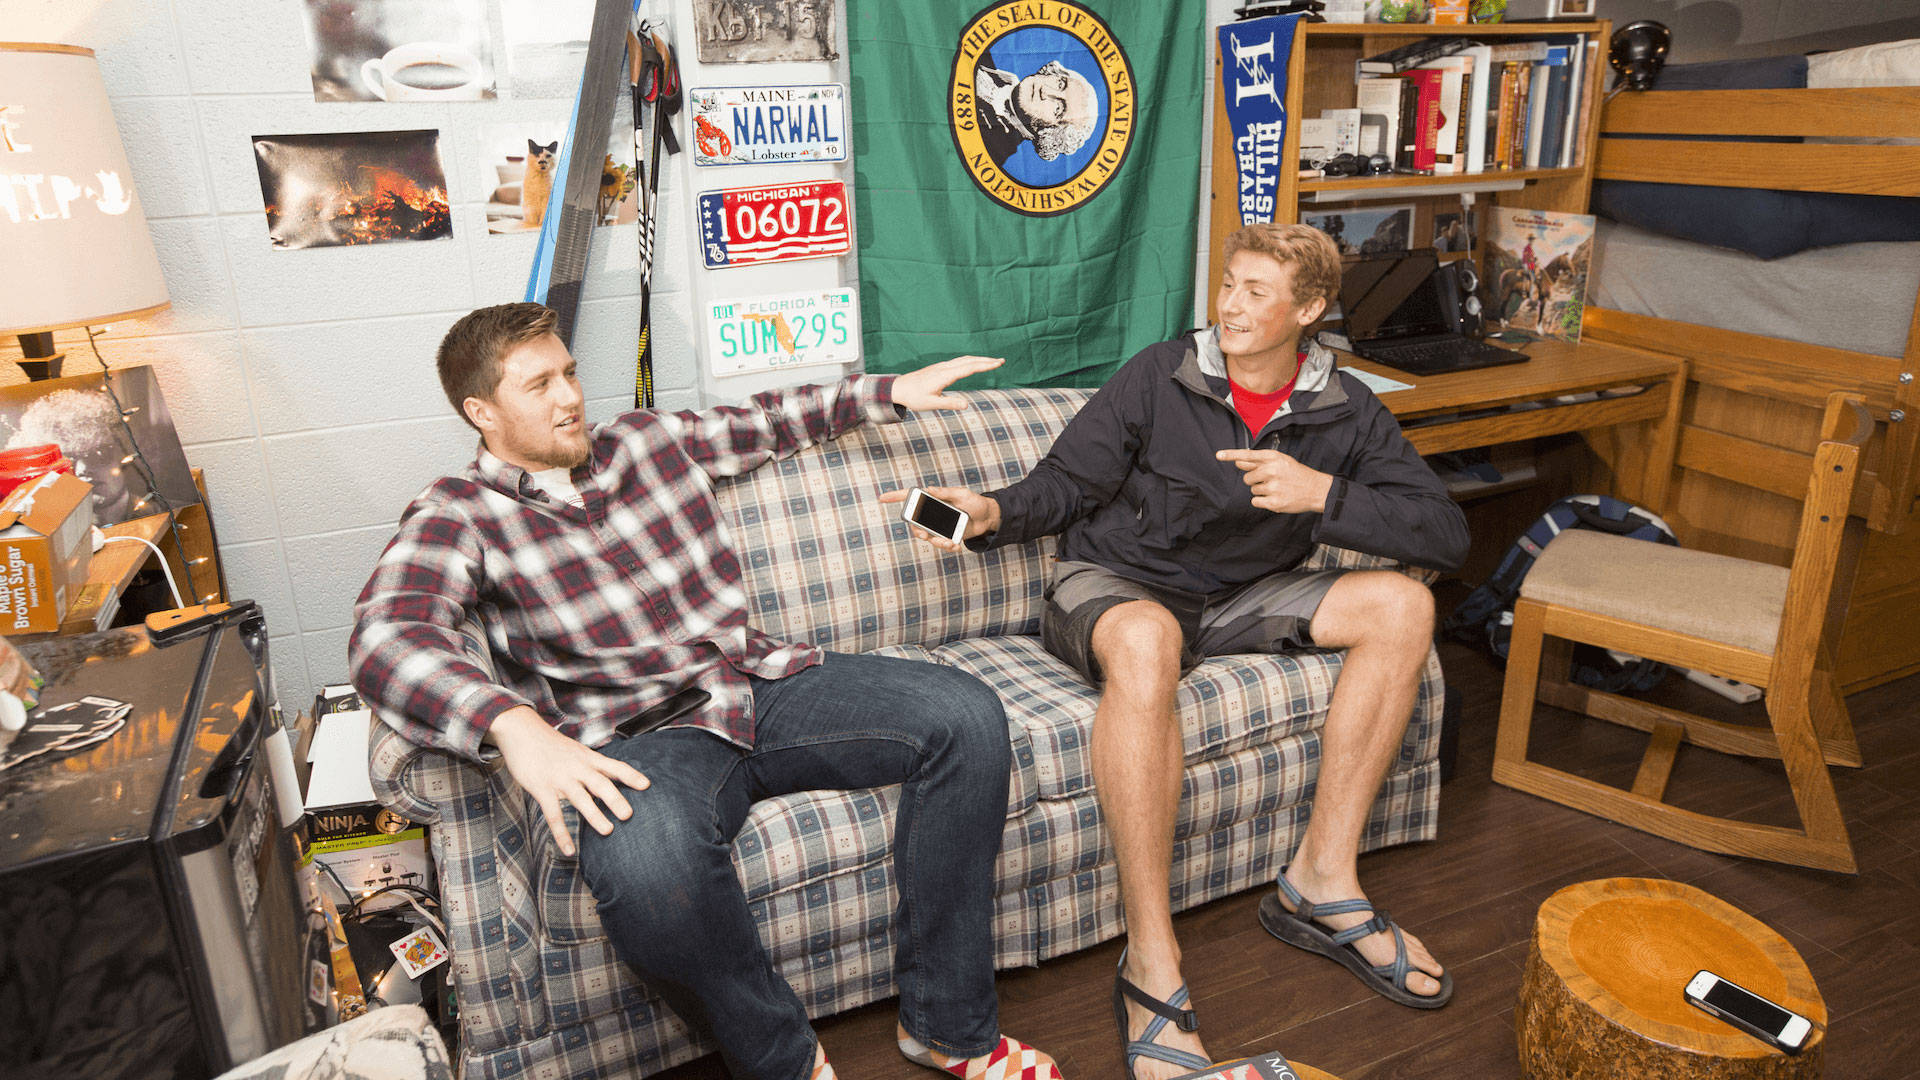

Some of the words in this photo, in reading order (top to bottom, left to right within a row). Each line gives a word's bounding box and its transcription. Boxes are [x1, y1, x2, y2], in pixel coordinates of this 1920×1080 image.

[997, 3, 1050, 28] SEAL
[1058, 7, 1086, 29] OF
[963, 20, 996, 60] THE
[1089, 23, 1120, 68] THE
[742, 90, 795, 102] MAINE
[821, 89, 835, 99] NOV
[956, 82, 975, 131] 1889
[1111, 70, 1130, 142] STATE
[733, 104, 839, 145] NARWAL
[752, 149, 797, 160] Lobster
[825, 146, 837, 154] 10
[1096, 148, 1119, 178] OF
[970, 152, 1098, 209] WASHINGTON
[737, 187, 810, 202] MICHIGAN
[717, 197, 844, 242] 106072
[707, 243, 725, 262] 76
[715, 306, 733, 319] JUL
[750, 298, 815, 313] FLORIDA
[720, 319, 778, 358] SUM
[792, 312, 847, 349] 29S
[769, 354, 805, 366] CLAY
[8, 546, 25, 585] Sugar
[14, 586, 30, 629] Brown
[315, 814, 368, 834] NINJA
